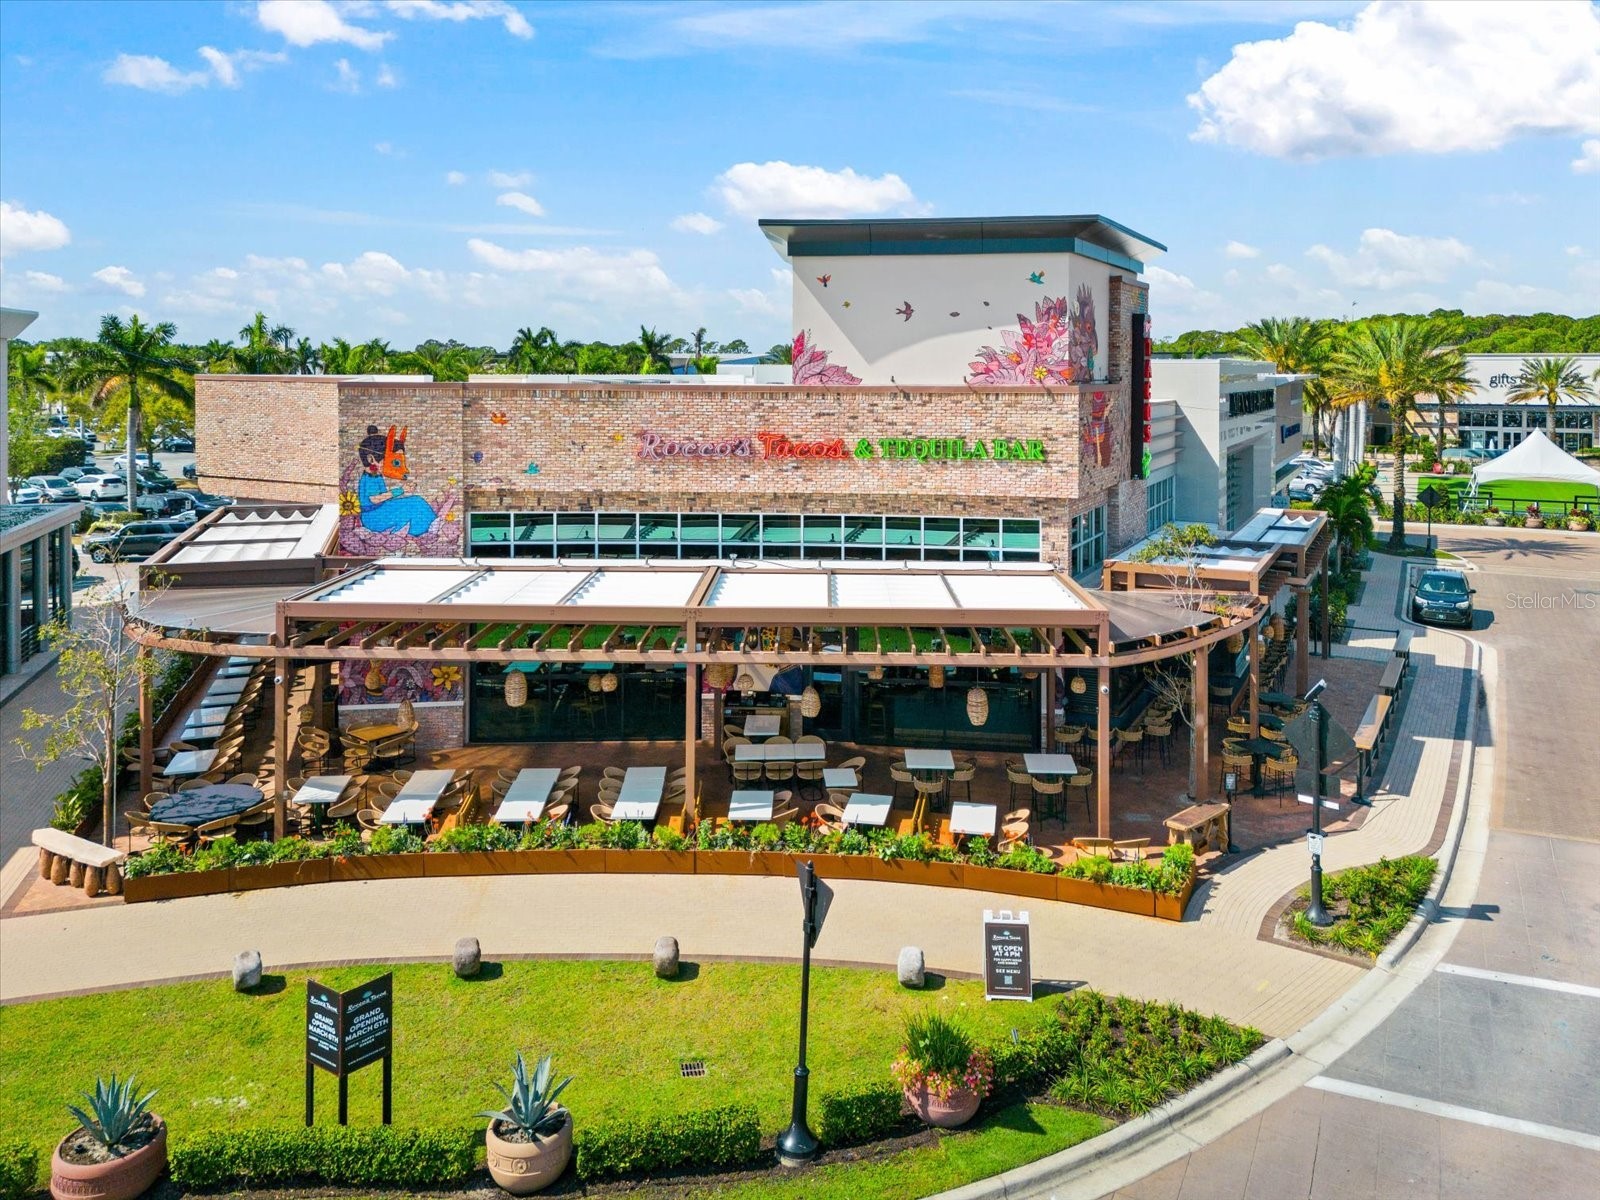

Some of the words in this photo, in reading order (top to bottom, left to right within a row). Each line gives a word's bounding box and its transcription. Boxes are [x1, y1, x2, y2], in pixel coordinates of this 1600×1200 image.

[1489, 373, 1517, 388] gifts
[638, 432, 754, 461] Rocco's
[758, 431, 849, 460] Tacos
[854, 437, 873, 461] &
[878, 437, 988, 463] TEQUILA
[992, 438, 1046, 461] BAR
[314, 1012, 334, 1026] GRAND
[349, 1012, 385, 1033] OPENING
[353, 1007, 381, 1024] GRAND
[308, 1024, 328, 1039] MARCH
[311, 1018, 336, 1035] OPENING
[344, 1025, 373, 1043] MARCH
[373, 1017, 389, 1029] 6TH
